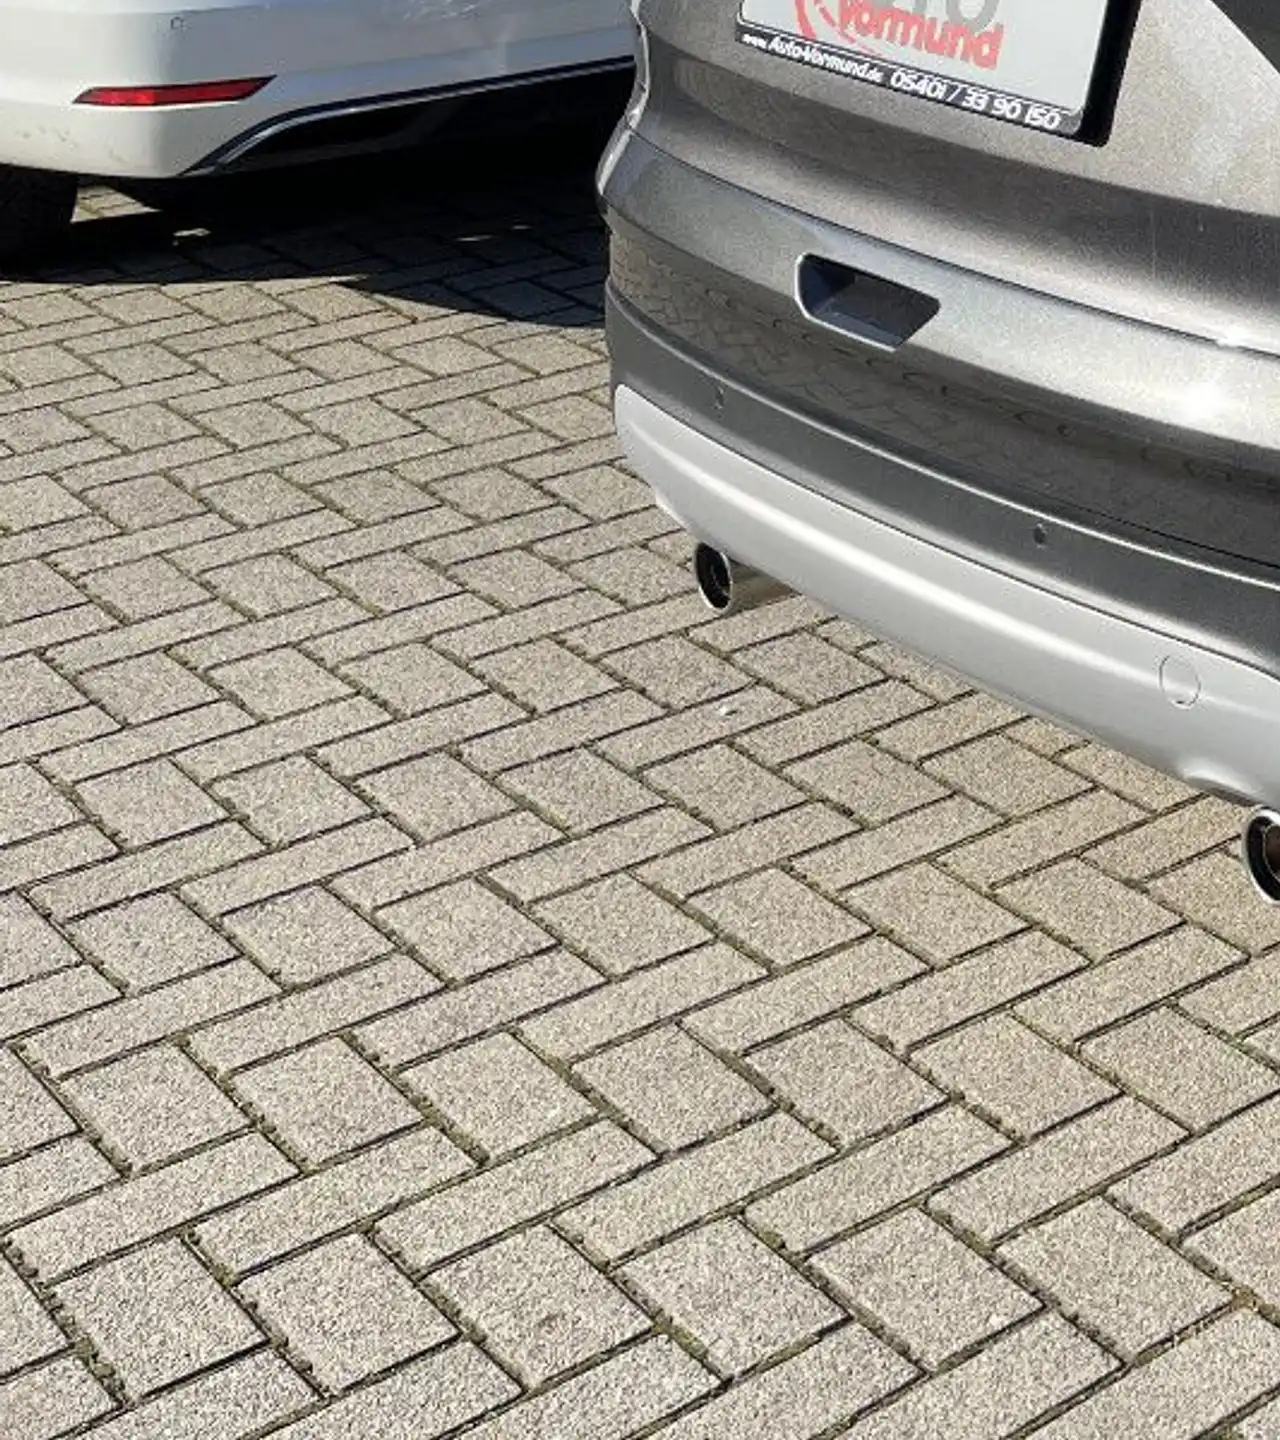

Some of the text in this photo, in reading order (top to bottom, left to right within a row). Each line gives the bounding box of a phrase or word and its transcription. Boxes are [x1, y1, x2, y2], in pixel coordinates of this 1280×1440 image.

[890, 71, 947, 100] 05401
[962, 90, 989, 111] 33
[991, 98, 1021, 120] 90
[1025, 106, 1061, 130] 150
